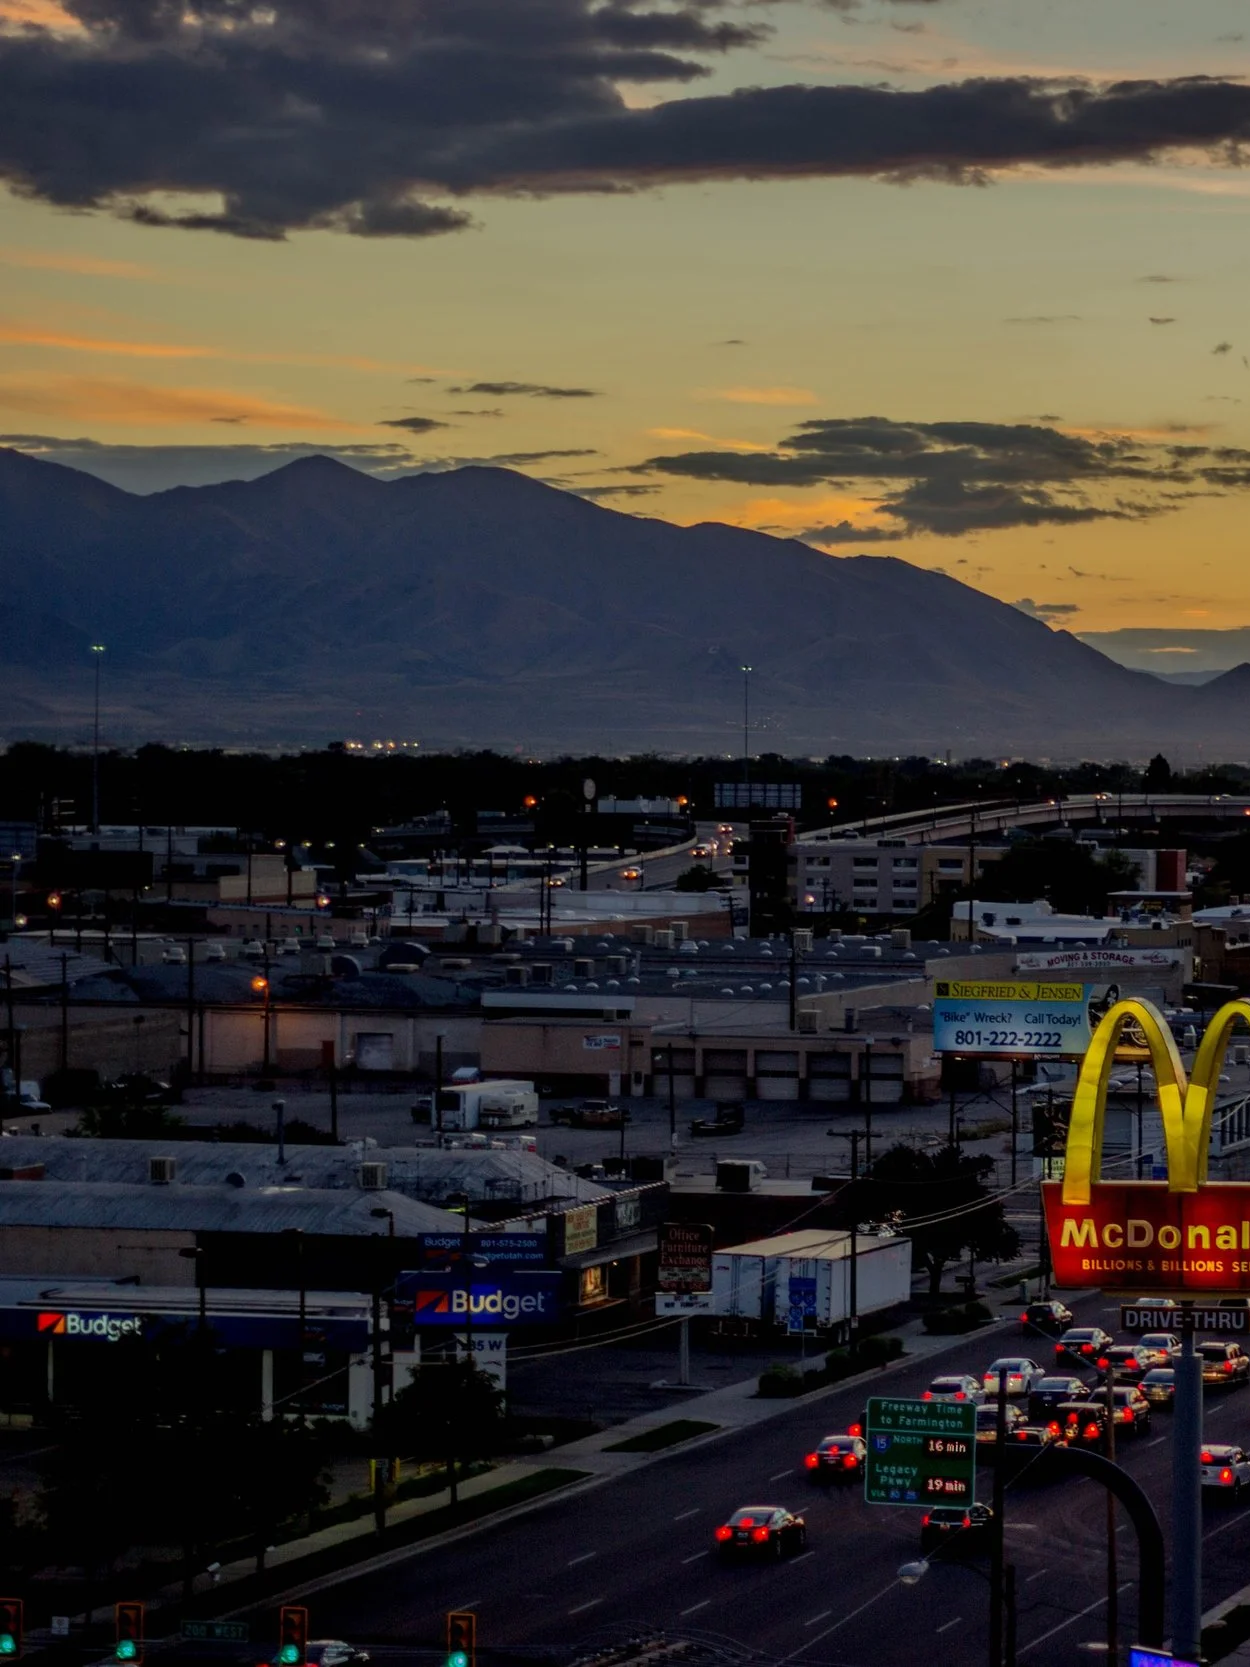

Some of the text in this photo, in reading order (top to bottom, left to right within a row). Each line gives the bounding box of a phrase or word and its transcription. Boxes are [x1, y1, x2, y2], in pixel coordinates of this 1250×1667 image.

[1047, 952, 1081, 967] MOVING
[1082, 952, 1088, 960] &
[1090, 951, 1135, 965] STORAGE
[951, 983, 1082, 1000] SIEGFRIED & JENSEN
[939, 1011, 1081, 1028] "Bike" Wreck? Call Today!
[955, 1030, 1062, 1047] 801-222-2222
[668, 1227, 700, 1240] Office
[424, 1236, 461, 1250] Budget
[660, 1240, 709, 1254] Furniture
[659, 1254, 707, 1268] Exchange
[1081, 1259, 1143, 1271] BILLIONS
[1147, 1260, 1156, 1271] &
[1161, 1260, 1224, 1272] BILLIONS
[451, 1289, 546, 1320] Budget
[66, 1313, 142, 1342] Budget
[1125, 1310, 1245, 1330] DRIVE-THRU
[488, 1340, 503, 1351] W
[881, 1401, 963, 1415] Freeway Time
[880, 1415, 963, 1430] to Farmington
[876, 1434, 966, 1453] 15 NORTH 16 min
[875, 1463, 918, 1477] Legacy
[879, 1475, 966, 1492] Pkwy 19 min
[214, 1626, 244, 1638] WEST
